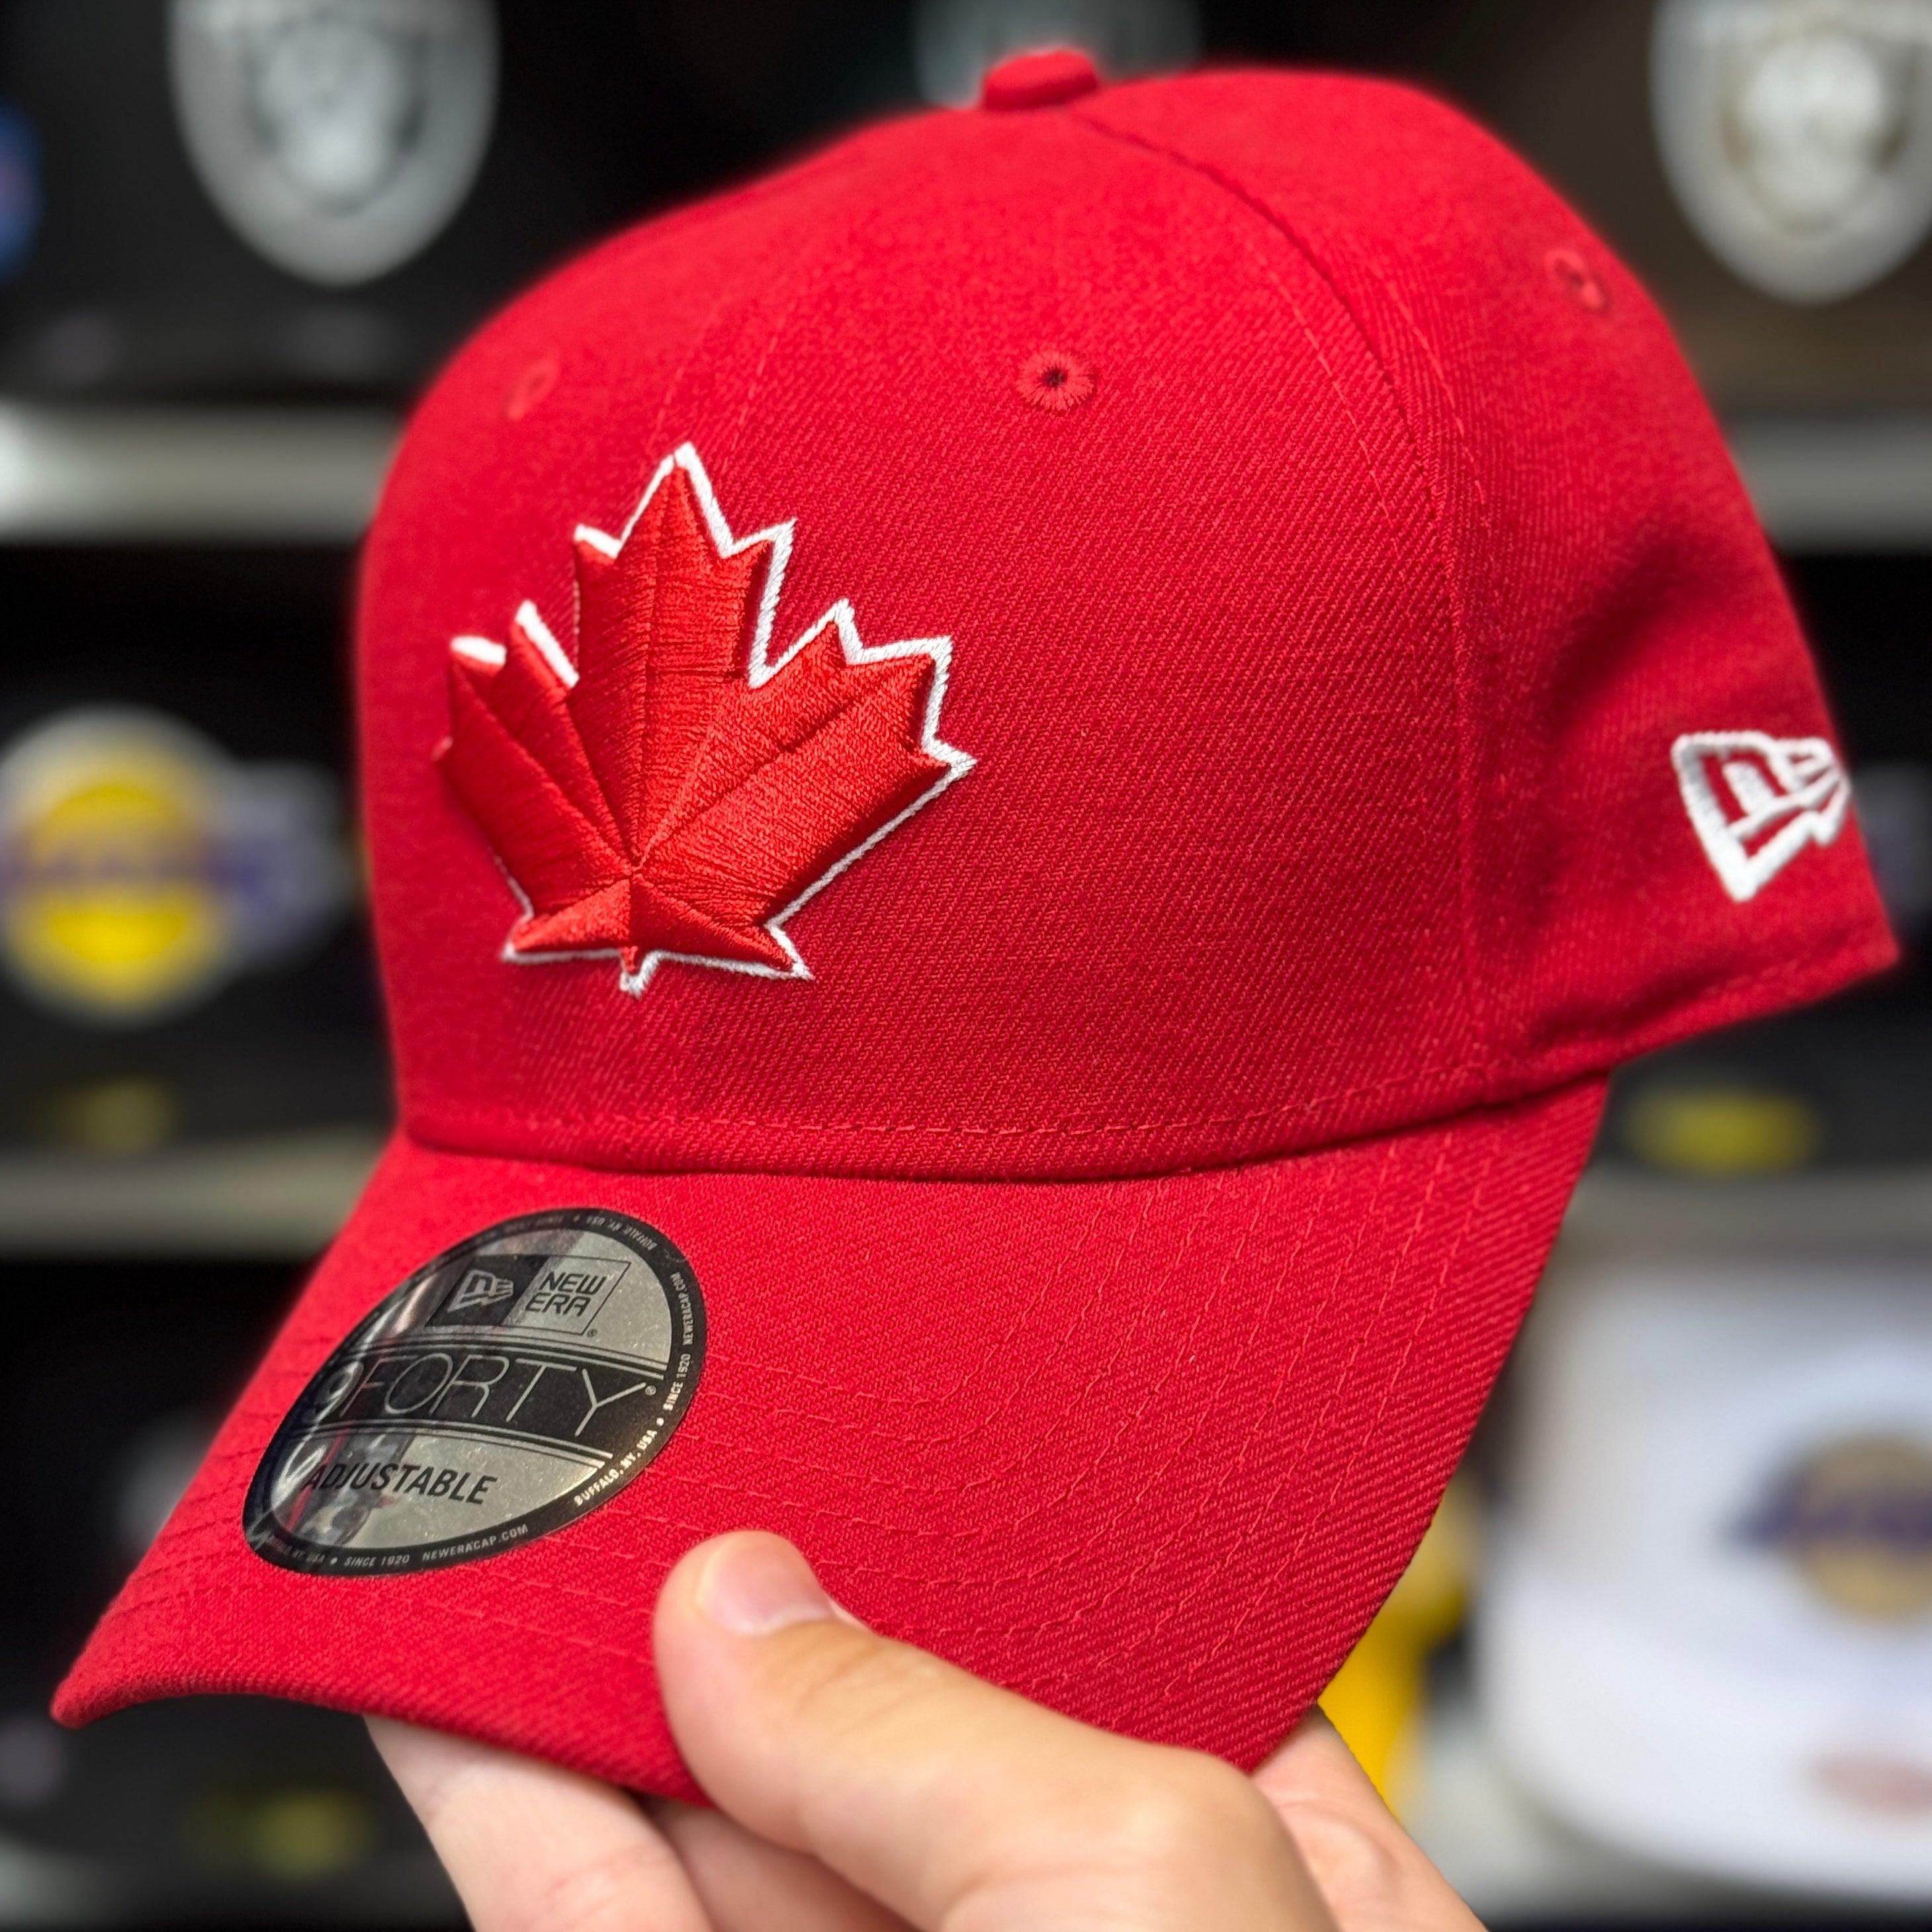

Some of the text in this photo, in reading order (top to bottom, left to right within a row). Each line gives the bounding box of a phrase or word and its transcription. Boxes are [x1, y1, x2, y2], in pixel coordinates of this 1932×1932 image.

[539, 1271, 607, 1295] NEW
[525, 1292, 591, 1317] ERA
[663, 1272, 693, 1411] SINCE 1920 NEWERACAP.COM
[637, 1430, 658, 1450] USA
[299, 1462, 498, 1505] ADJUSTABLE
[344, 1556, 376, 1567] SINCE
[381, 1554, 410, 1566] 1920
[422, 1524, 529, 1562] NEWERACAP.COM
